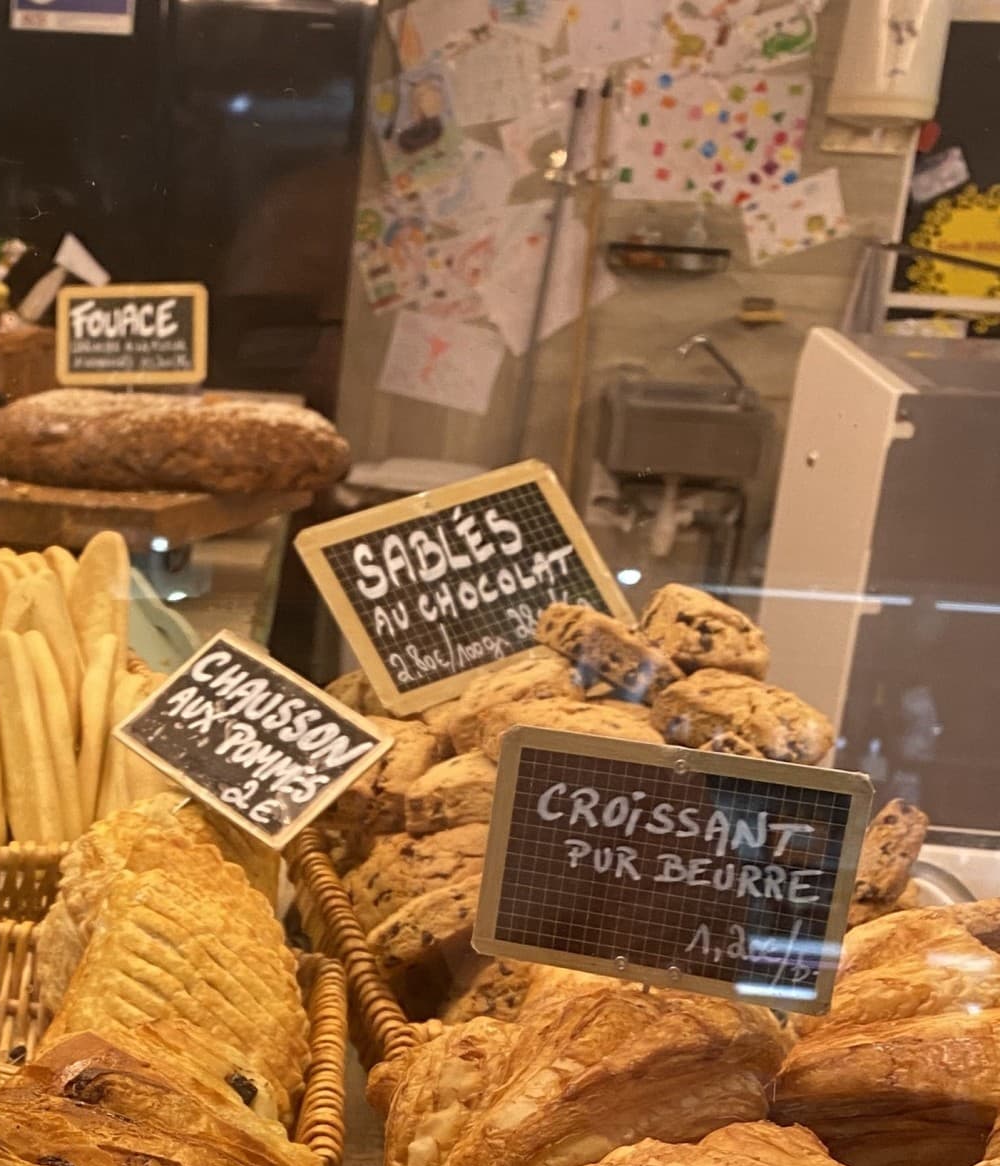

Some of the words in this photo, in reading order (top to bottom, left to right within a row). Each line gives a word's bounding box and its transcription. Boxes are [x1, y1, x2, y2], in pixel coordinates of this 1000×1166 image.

[71, 300, 179, 338] FOUACE
[353, 506, 523, 600] SABLÉS
[373, 603, 410, 637] AU
[418, 544, 573, 622] CHOCOLAT
[166, 686, 226, 734] AUX
[190, 651, 374, 768] CHAUSSON
[214, 722, 331, 803] POMMES
[563, 838, 642, 881] PUR
[653, 852, 825, 903] BEURRE
